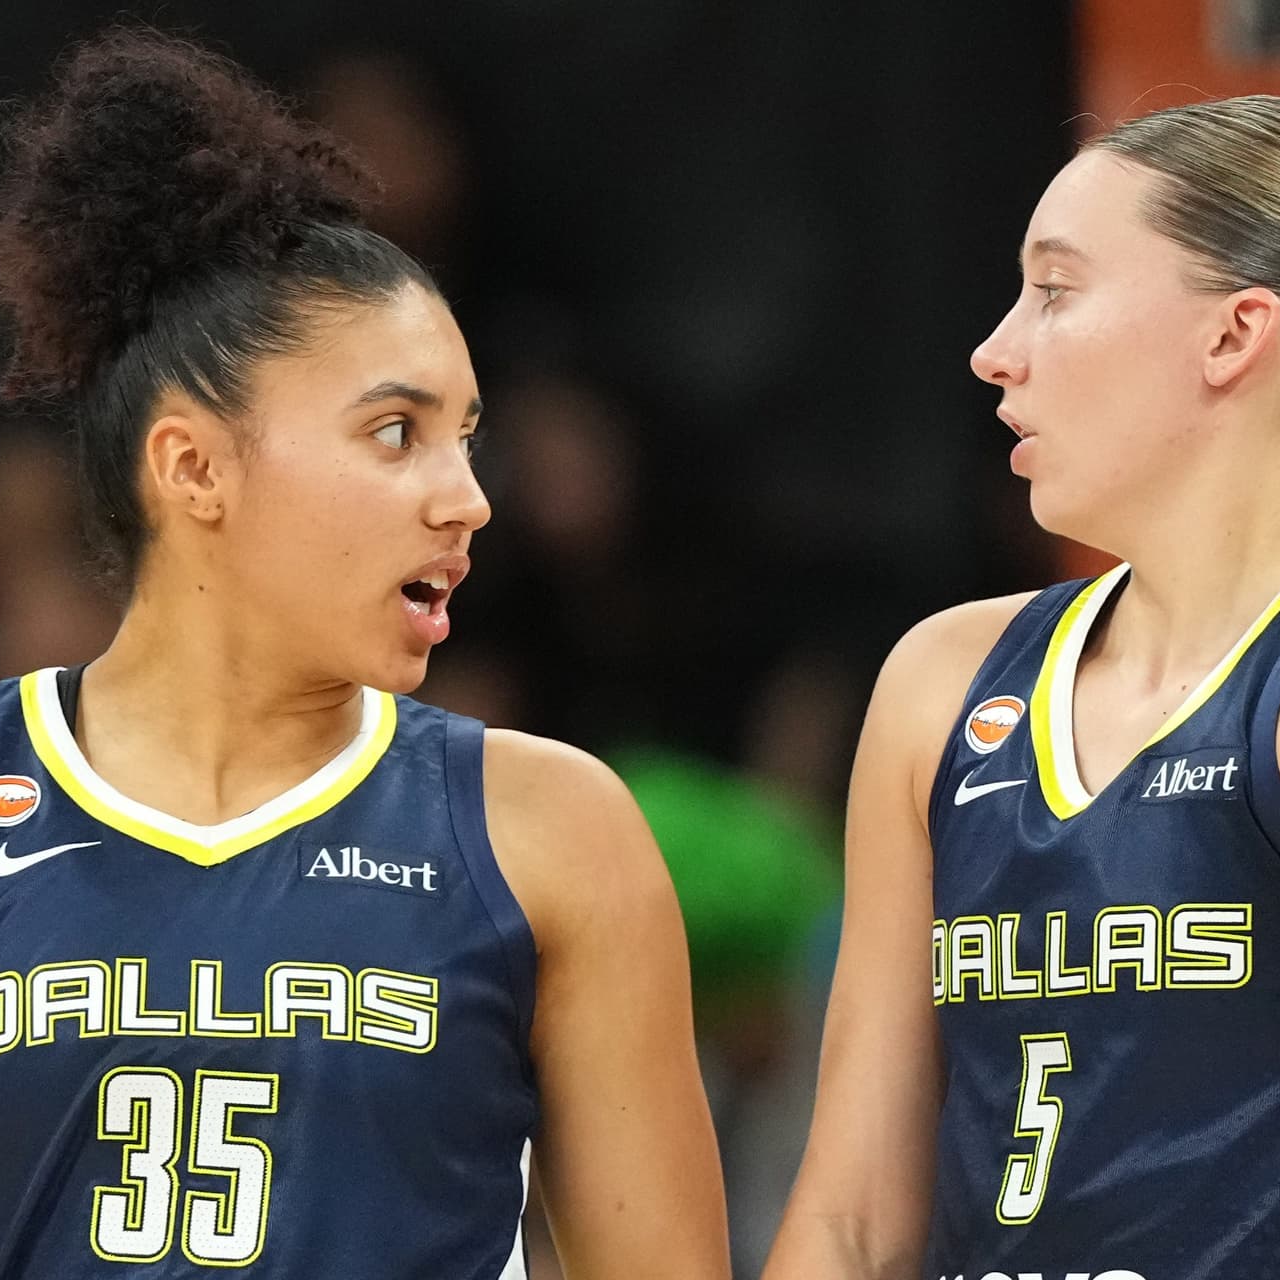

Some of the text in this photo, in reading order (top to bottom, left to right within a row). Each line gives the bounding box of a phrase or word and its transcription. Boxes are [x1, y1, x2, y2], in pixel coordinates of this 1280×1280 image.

[1142, 757, 1238, 798] Albert
[304, 846, 437, 891] Albert
[90, 1066, 279, 1267] 35
[996, 1032, 1072, 1225] 5
